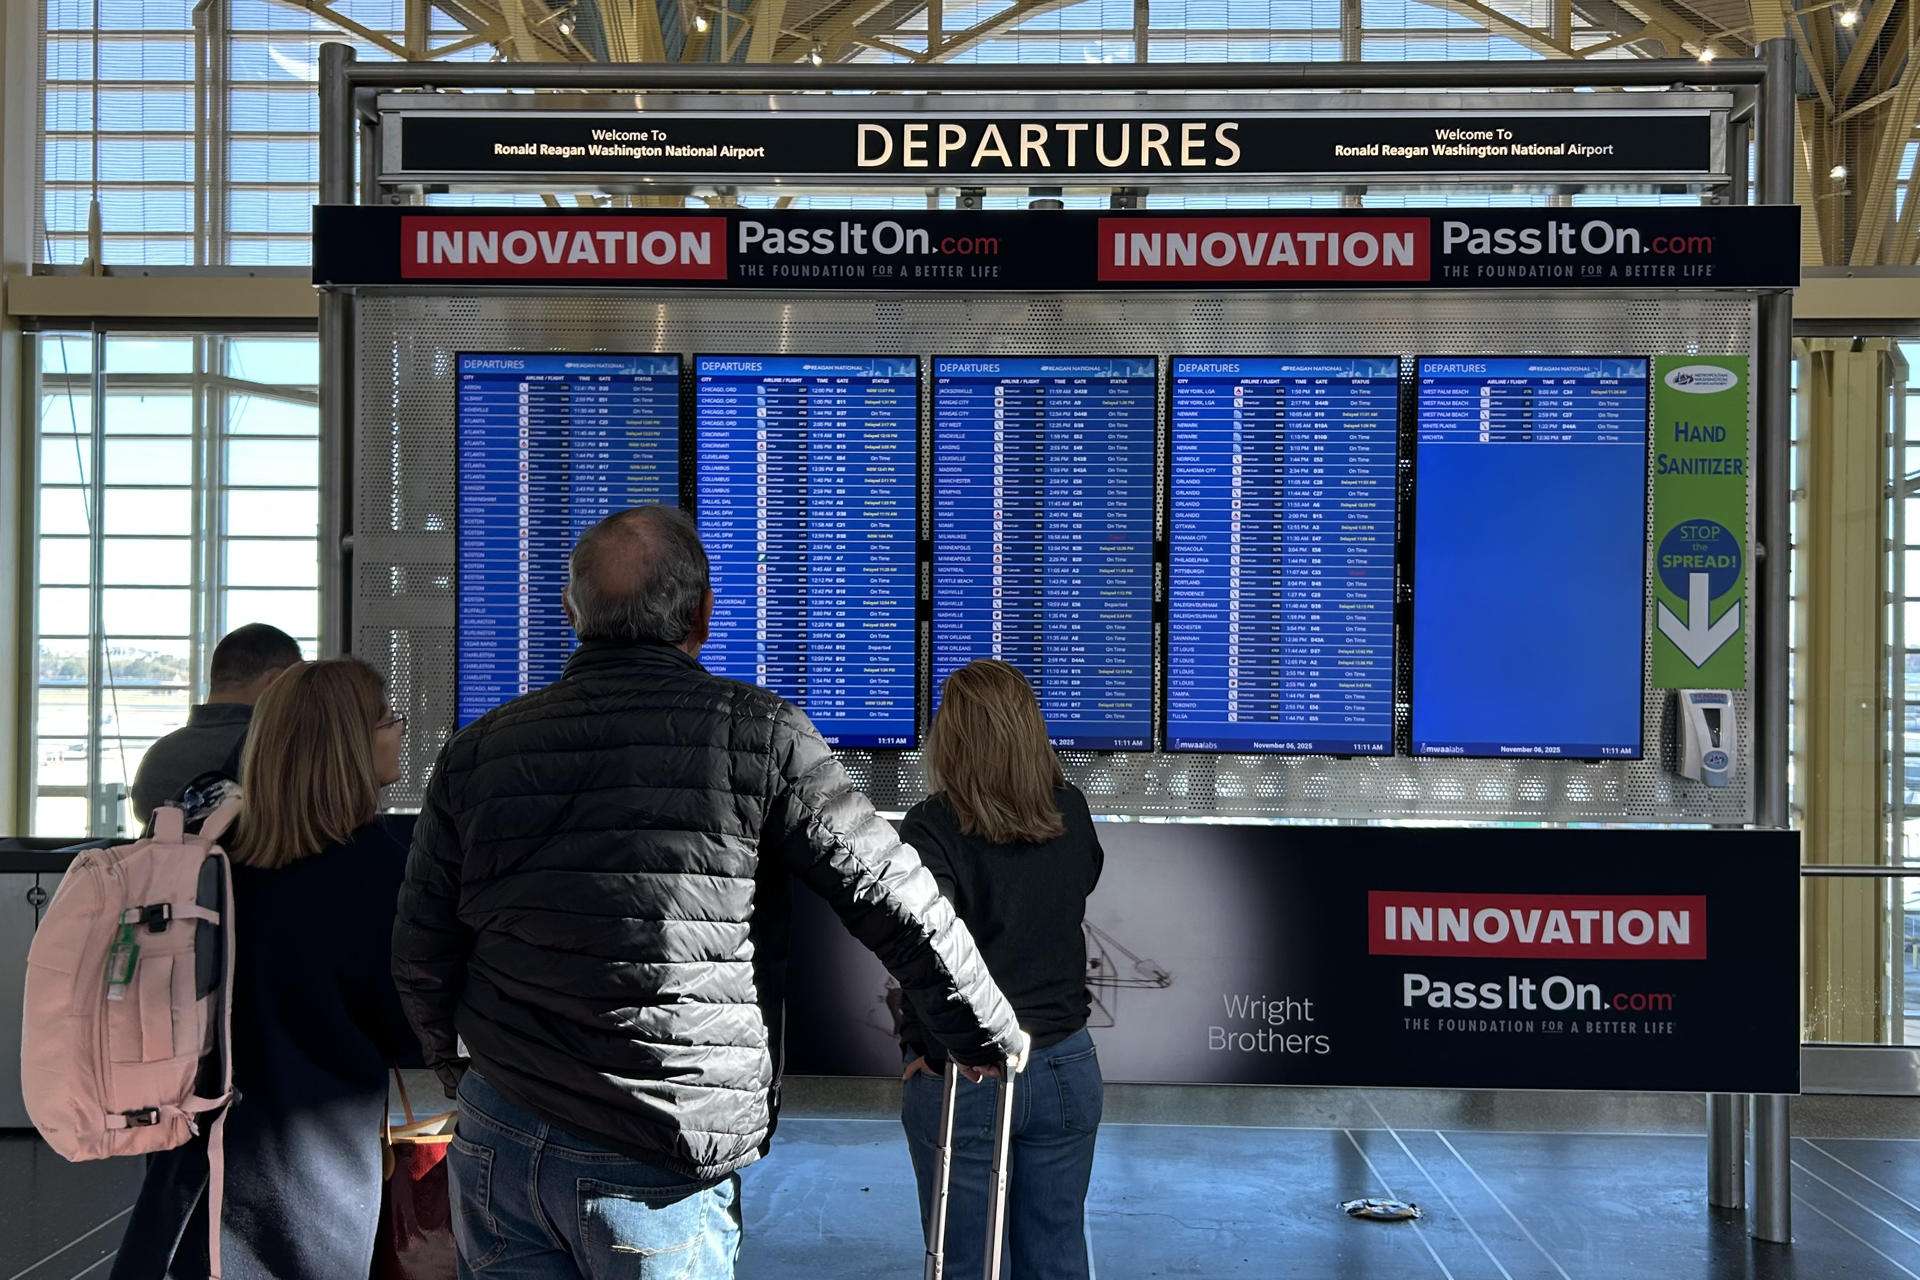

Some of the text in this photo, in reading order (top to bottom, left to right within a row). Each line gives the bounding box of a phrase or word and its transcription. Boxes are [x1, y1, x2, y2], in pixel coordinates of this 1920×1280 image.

[592, 129, 667, 141] Welcome To
[1435, 128, 1513, 140] Welcome To
[494, 143, 765, 160] Ronald Reagan Washington National Airport
[857, 123, 1240, 167] DEPARTURES
[1335, 143, 1614, 158] Ronald Reagan Washington National Airport
[417, 230, 711, 265] INNOVATION
[1114, 232, 1414, 266] INNOVATION
[739, 264, 998, 278] THE FOUNDATION FOR A BETTER LIFE
[1443, 264, 1712, 277] THE FOUNDATION FOR A BETTER LIFE
[464, 359, 525, 369] DEPARTURES
[702, 362, 762, 371] DEPARTURES
[940, 363, 1000, 373] DEPARTURES
[1179, 363, 1240, 373] DEPARTURES
[1424, 364, 1486, 373] DEPARTURES
[1674, 422, 1726, 442] HAND
[1657, 453, 1743, 476] SANITIZER
[1680, 526, 1721, 540] STOP
[1661, 555, 1737, 569] SPREAD!
[1385, 906, 1690, 945] INNOVATION
[1222, 990, 1313, 1026] Wright
[1404, 1018, 1672, 1034] THE FOUNDATION FOR A BETTER LIFE
[1206, 1024, 1330, 1056] Brothers
